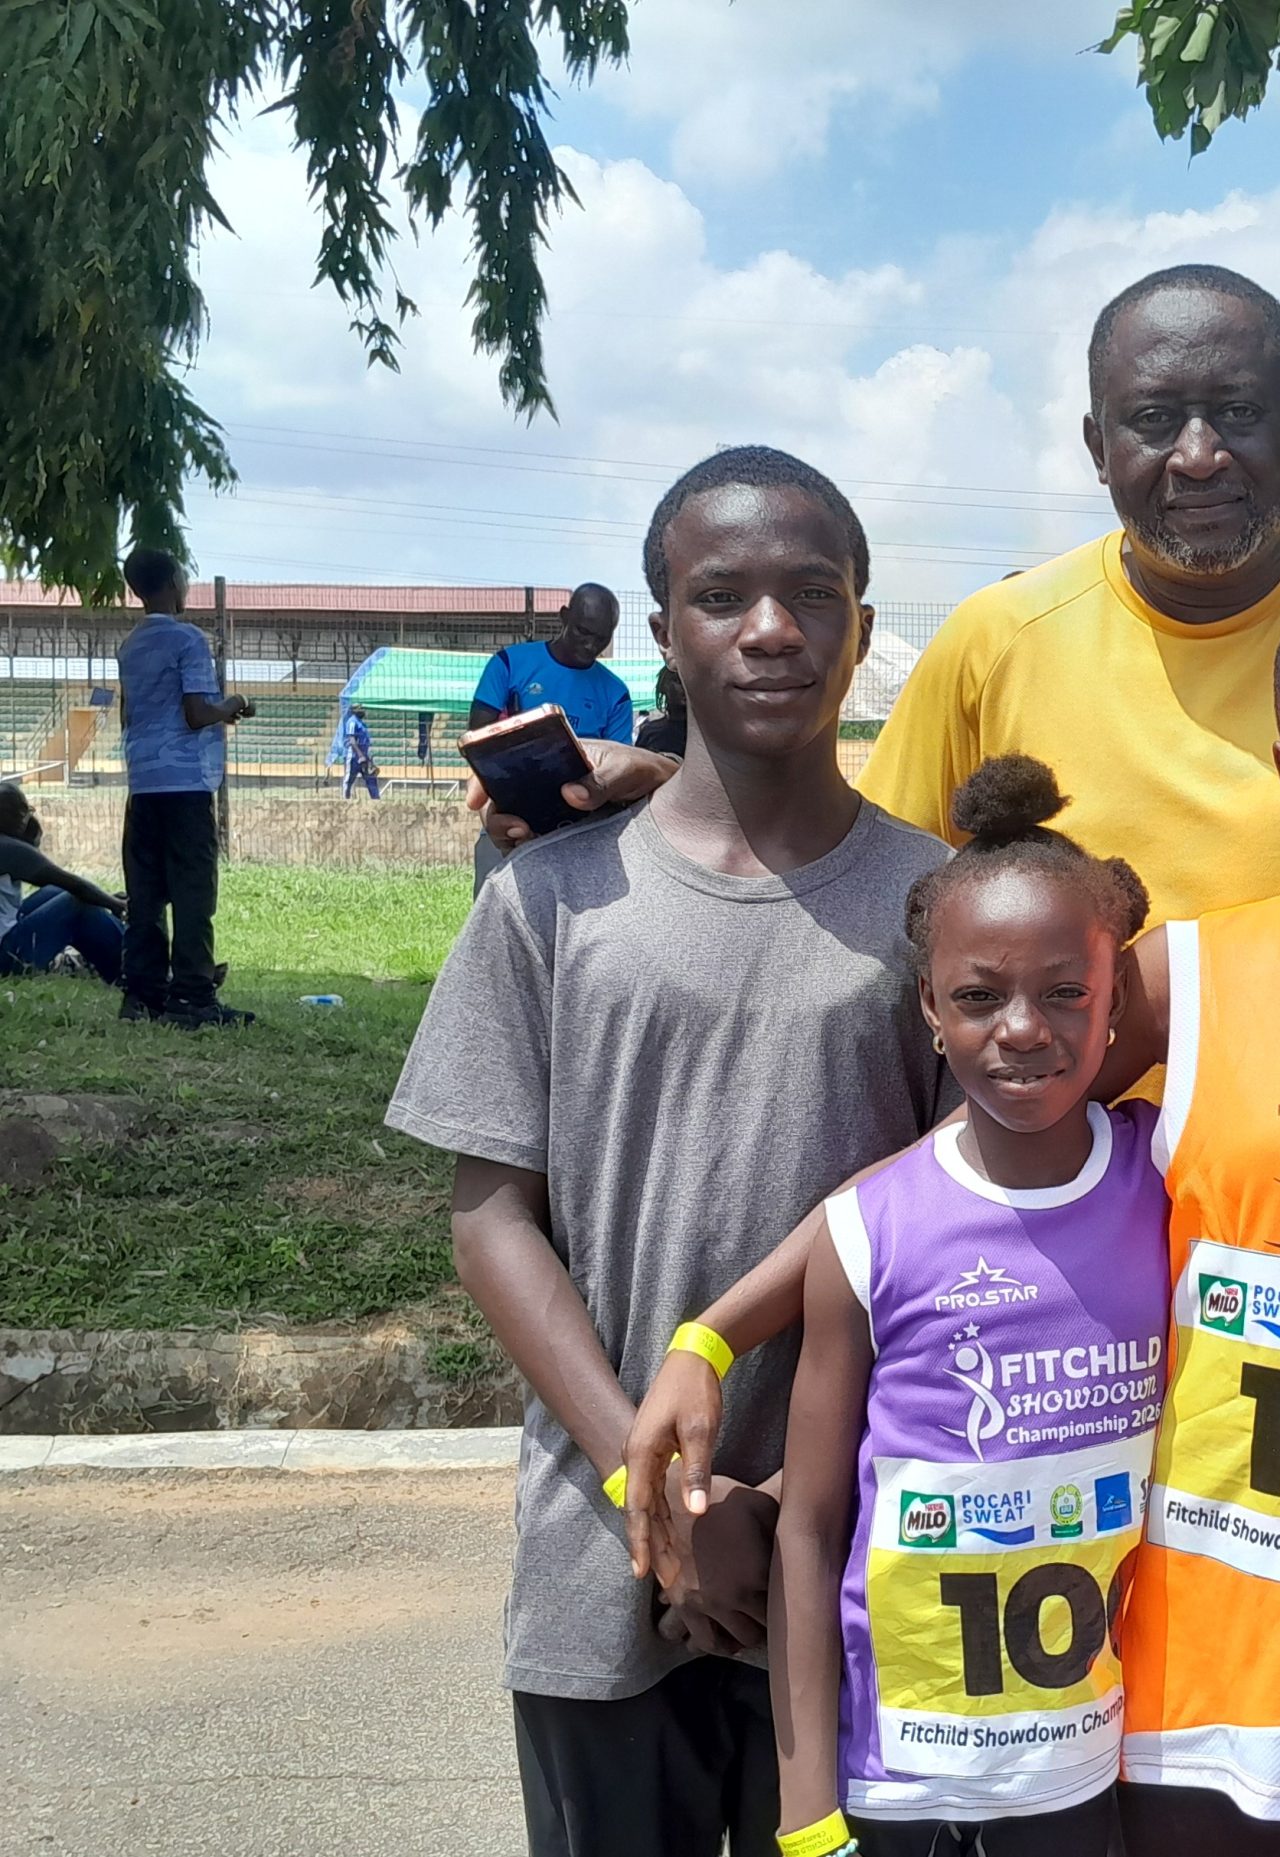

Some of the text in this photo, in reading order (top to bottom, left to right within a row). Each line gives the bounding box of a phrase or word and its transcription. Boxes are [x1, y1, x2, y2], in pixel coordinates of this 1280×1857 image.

[1208, 1293, 1239, 1313] MILO
[1000, 1335, 1162, 1388] FITCHILD
[1005, 1402, 1162, 1445] Championship 2026
[962, 1489, 1031, 1509] POCARI
[907, 1510, 947, 1531] MILO
[963, 1506, 1025, 1524] SWEAT
[1165, 1500, 1230, 1533] Fitchild
[900, 1721, 969, 1747] Fitchild
[972, 1722, 1077, 1748] Showdown
